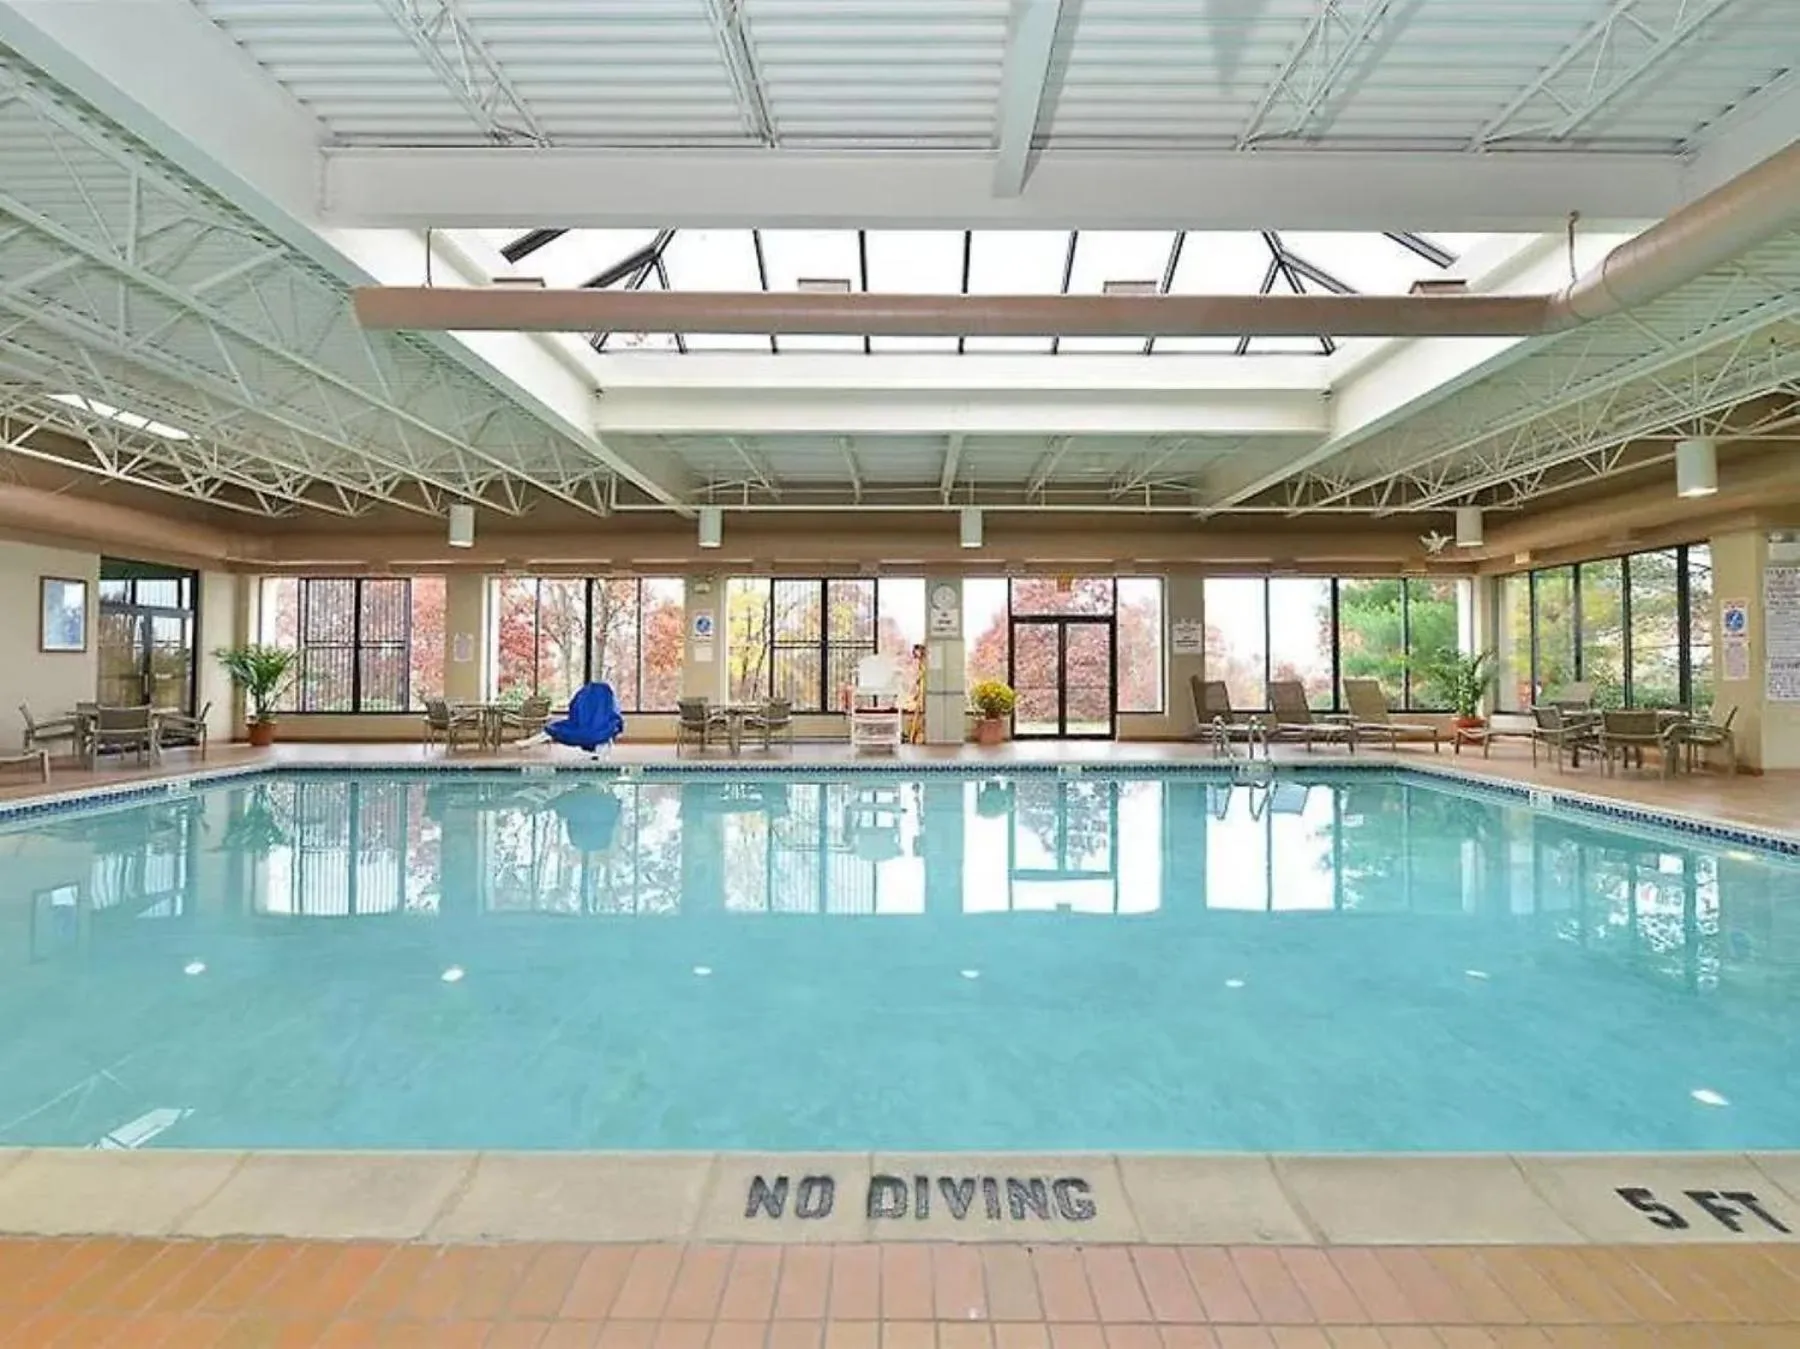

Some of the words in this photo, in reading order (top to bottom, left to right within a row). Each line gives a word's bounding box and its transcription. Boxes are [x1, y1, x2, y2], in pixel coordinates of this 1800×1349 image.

[744, 1174, 836, 1219] NO
[866, 1174, 1097, 1222] DIVING
[1613, 1187, 1690, 1229] 5
[1681, 1190, 1793, 1234] FT
